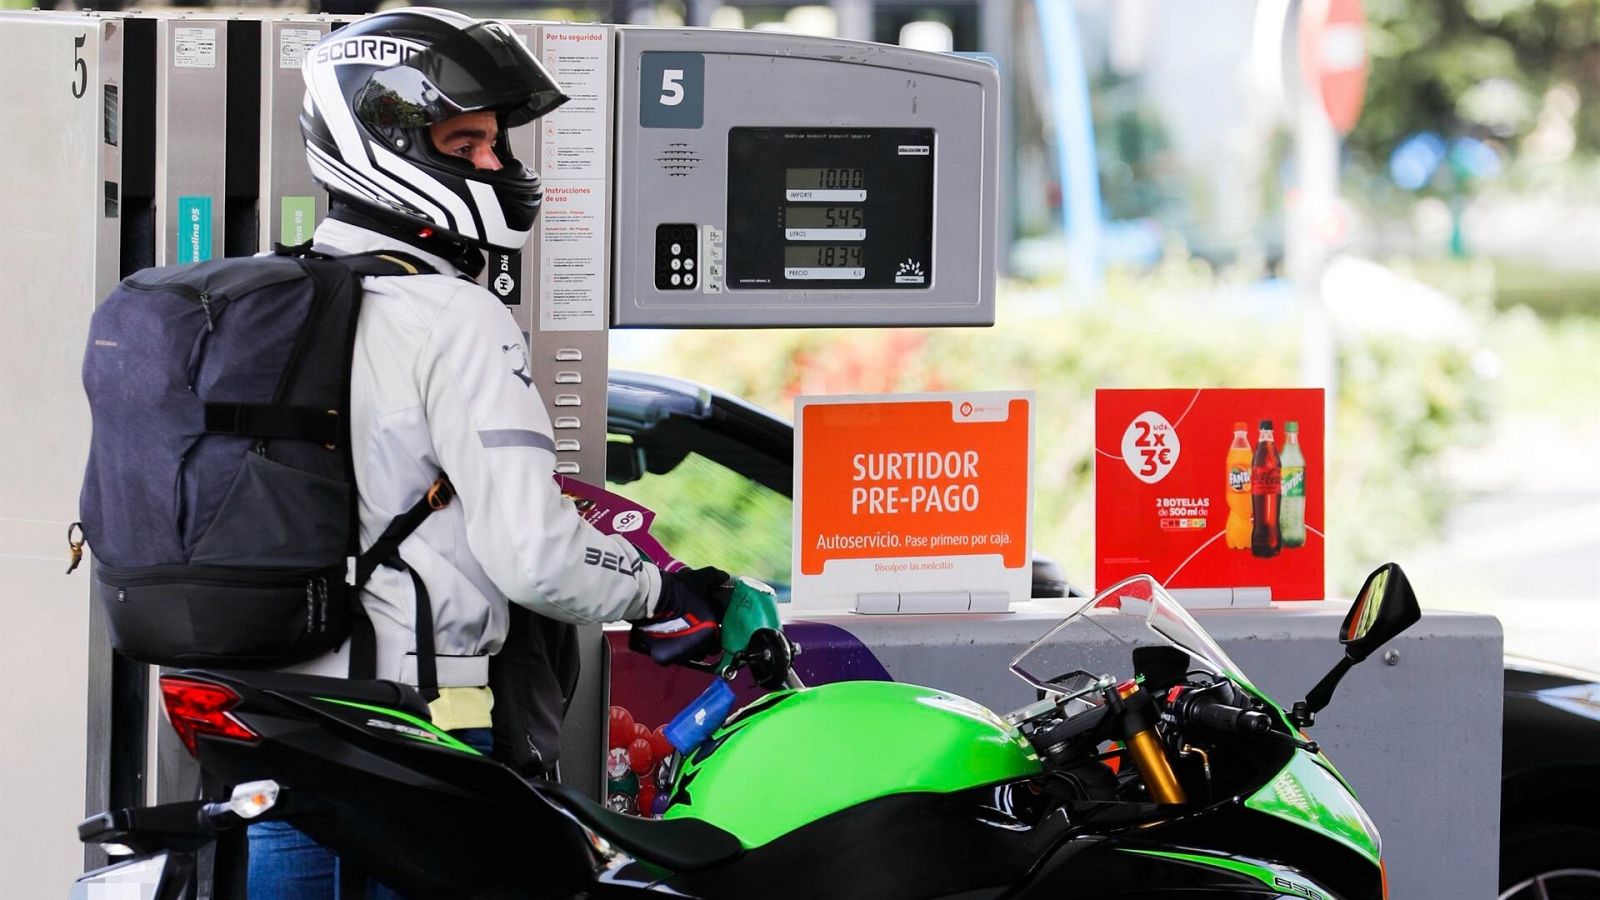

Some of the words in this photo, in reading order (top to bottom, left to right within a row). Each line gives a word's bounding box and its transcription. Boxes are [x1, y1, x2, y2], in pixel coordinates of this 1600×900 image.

[568, 33, 602, 42] seguridad
[72, 33, 87, 98] 5
[660, 69, 685, 106] 5
[820, 169, 862, 188] 10.00
[192, 208, 199, 221] 95
[826, 208, 861, 228] 5.45
[191, 225, 199, 262] asolina
[500, 254, 509, 271] Dié
[817, 247, 862, 267] 1.834
[852, 450, 979, 481] SURTIDOR
[851, 484, 980, 515] PRE-PAGO
[1156, 498, 1162, 507] 2
[1163, 498, 1210, 507] BOTELLAS
[1158, 508, 1168, 516] de
[1169, 508, 1187, 516] 500
[1187, 508, 1197, 516] ml
[1198, 508, 1208, 516] de
[816, 531, 901, 550] Autoservicio.
[905, 534, 927, 547] Pase
[930, 533, 969, 549] primero
[971, 534, 987, 548] por
[990, 532, 1012, 547] caja.
[874, 562, 909, 572] Disculpen
[909, 562, 919, 570] las
[921, 561, 954, 570] molestias
